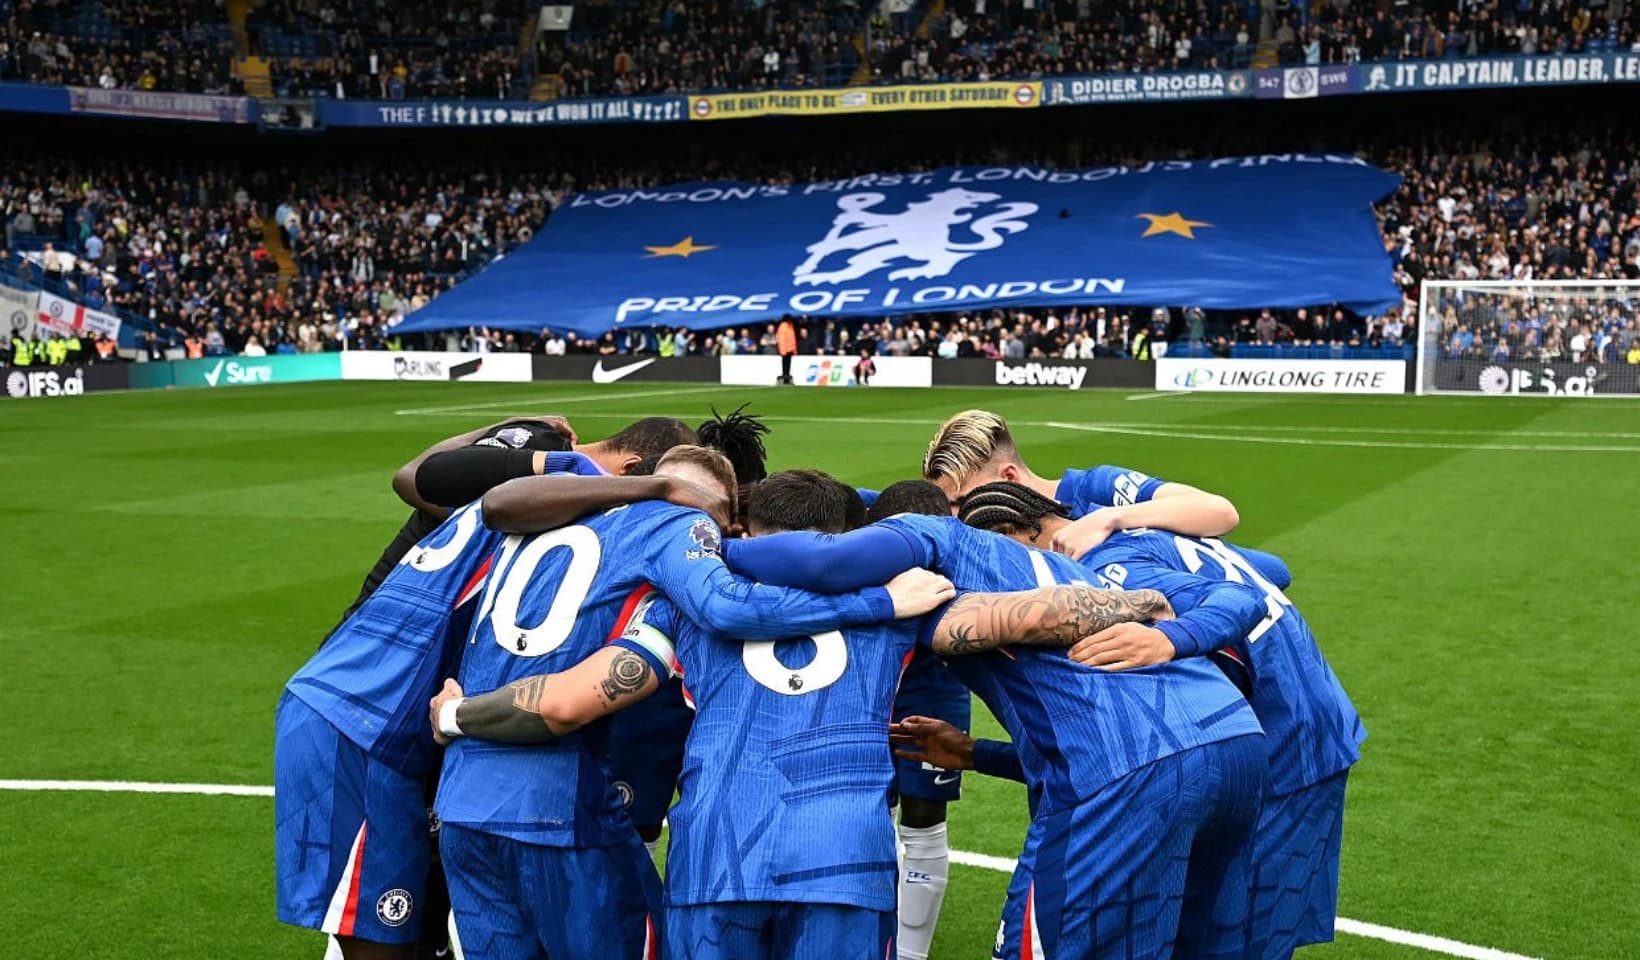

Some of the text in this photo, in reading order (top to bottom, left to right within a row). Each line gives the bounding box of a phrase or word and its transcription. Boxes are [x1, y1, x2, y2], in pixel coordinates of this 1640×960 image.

[1072, 74, 1225, 94] DIDIER DROGBA
[1395, 56, 1640, 87] JT CAPTAIN, LEADER, LE
[556, 104, 589, 120] WON
[591, 102, 605, 119] IT
[607, 100, 629, 118] ALL
[716, 99, 736, 113] THE
[740, 97, 765, 111] ONLY
[768, 95, 801, 109] PLACE
[805, 95, 819, 108] TO
[823, 95, 837, 108] BE
[871, 91, 906, 105] EVERY
[909, 89, 947, 103] OTHER
[949, 87, 1010, 102] SATURDAY
[379, 107, 413, 123] THE
[571, 185, 788, 209] LONDON'S
[615, 293, 779, 322] PRIDE
[790, 289, 871, 312] OF
[29, 368, 84, 397] IFS.ai
[227, 361, 272, 384] Sure
[995, 361, 1088, 390] betway
[1219, 370, 1386, 389] LINGLONG TIRE
[470, 524, 602, 658] 10
